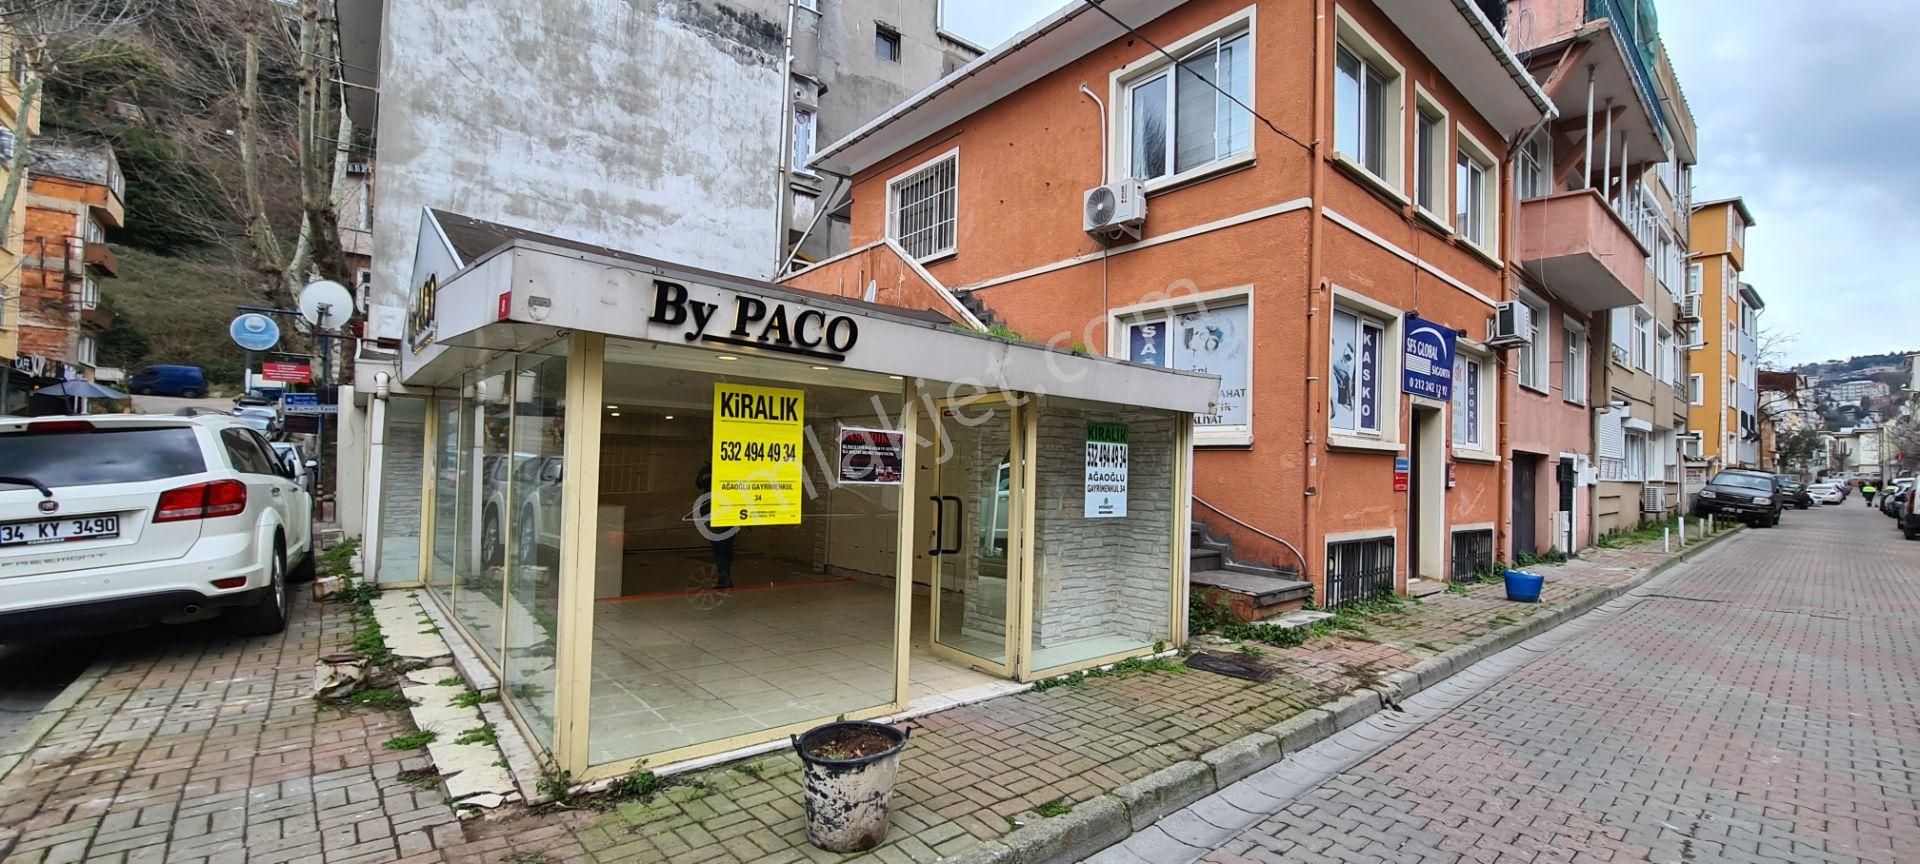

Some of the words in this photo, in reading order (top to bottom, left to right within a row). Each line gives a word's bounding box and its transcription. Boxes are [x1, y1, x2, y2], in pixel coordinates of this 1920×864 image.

[649, 279, 718, 341] By
[731, 295, 858, 352] PACO
[1406, 337, 1417, 354] SFS
[1417, 341, 1438, 360] GLOBAL
[1361, 333, 1372, 416] KASKO
[1409, 377, 1414, 387] 0
[1414, 379, 1425, 391] 212
[720, 441, 741, 462] 532
[744, 441, 764, 462] 494
[767, 442, 780, 462] 49
[783, 443, 796, 462] 34
[721, 482, 751, 491] AĞAOĞLU
[1088, 472, 1125, 482] AĞAOĞLU
[1119, 484, 1126, 493] 34
[2, 525, 24, 541] 34
[38, 522, 59, 538] KY
[72, 518, 115, 535] 3490
